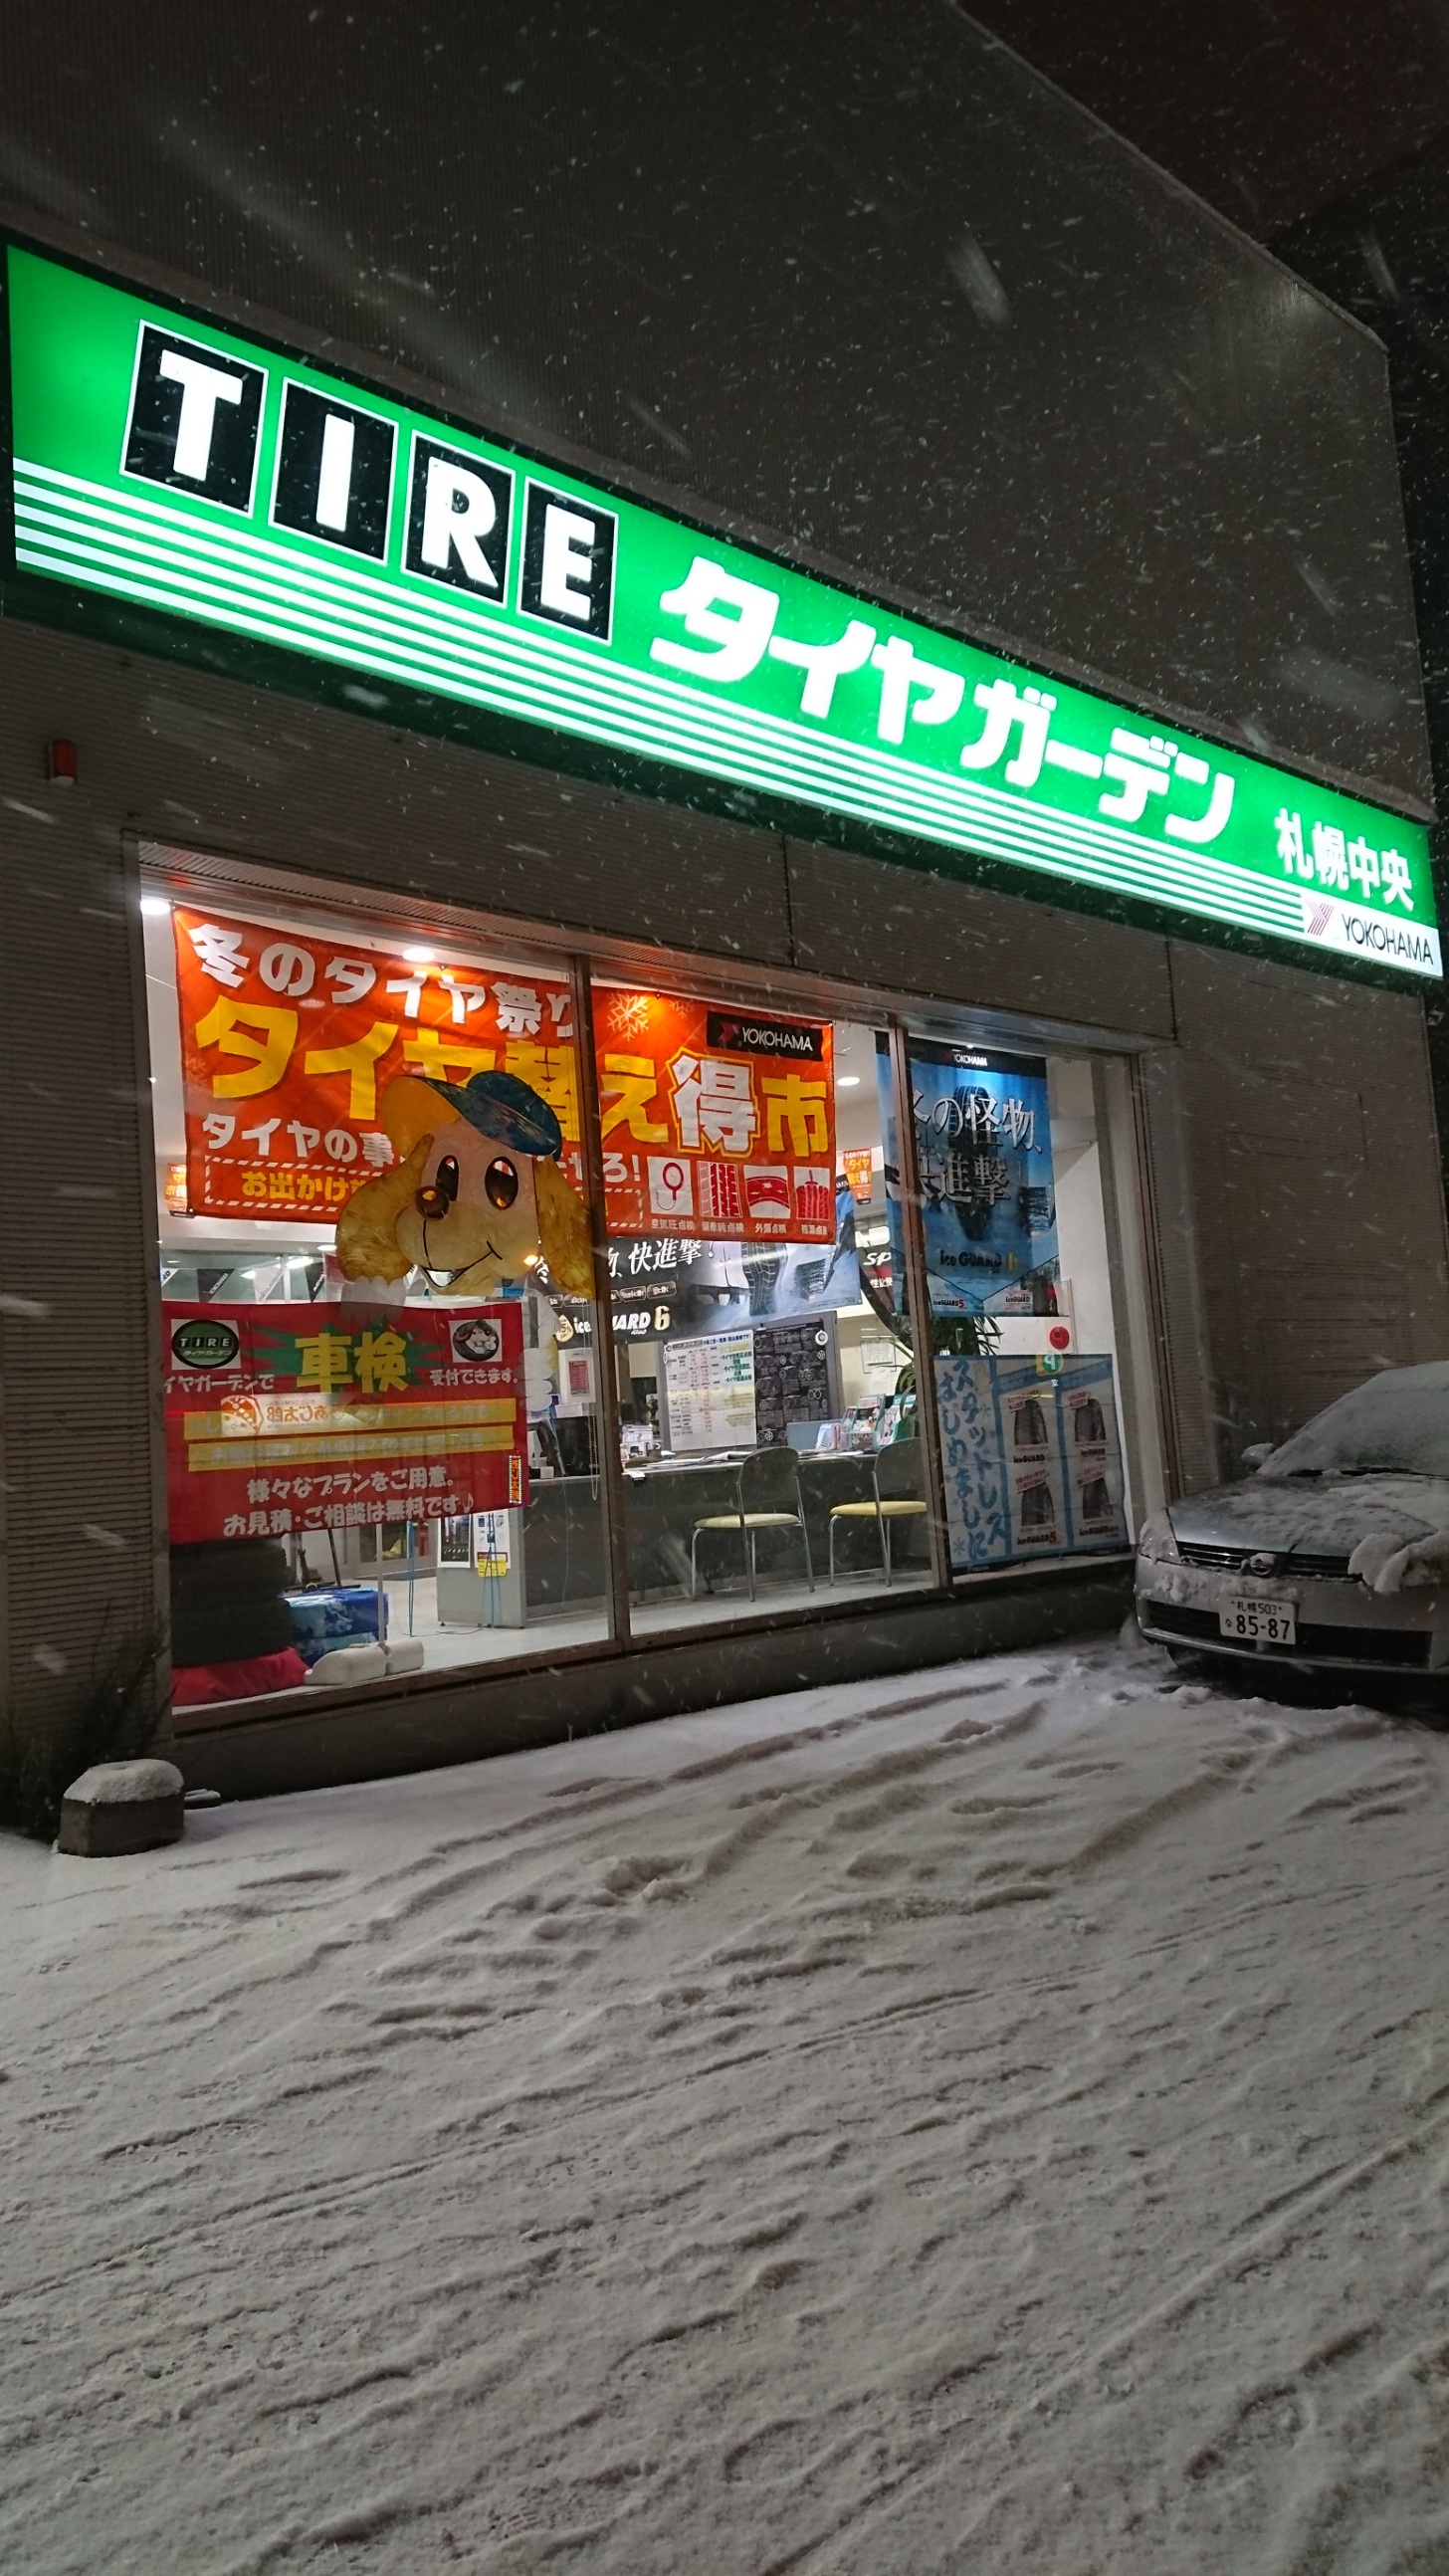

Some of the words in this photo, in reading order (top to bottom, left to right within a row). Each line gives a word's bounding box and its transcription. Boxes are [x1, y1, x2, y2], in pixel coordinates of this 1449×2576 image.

[158, 348, 596, 621] TIRE
[650, 555, 1234, 843] タイヤガーデン
[1274, 807, 1414, 912] 札幌中央
[1342, 913, 1434, 966] YOKOHAMA
[187, 922, 573, 1038] 冬のタイヤ祭り
[741, 1026, 814, 1052] YOKOHAMA
[954, 1053, 989, 1067] YOKOHAMA
[179, 1337, 231, 1348] TIRE
[654, 1305, 671, 1332] 6
[295, 1331, 409, 1394] 車検
[429, 1368, 518, 1387] 受付できます。
[936, 1370, 989, 1562] はじめました
[952, 1358, 1006, 1546] スタッドレス
[246, 1465, 454, 1504] 様々なプランをご用意。
[1236, 1613, 1291, 1640] 85-87
